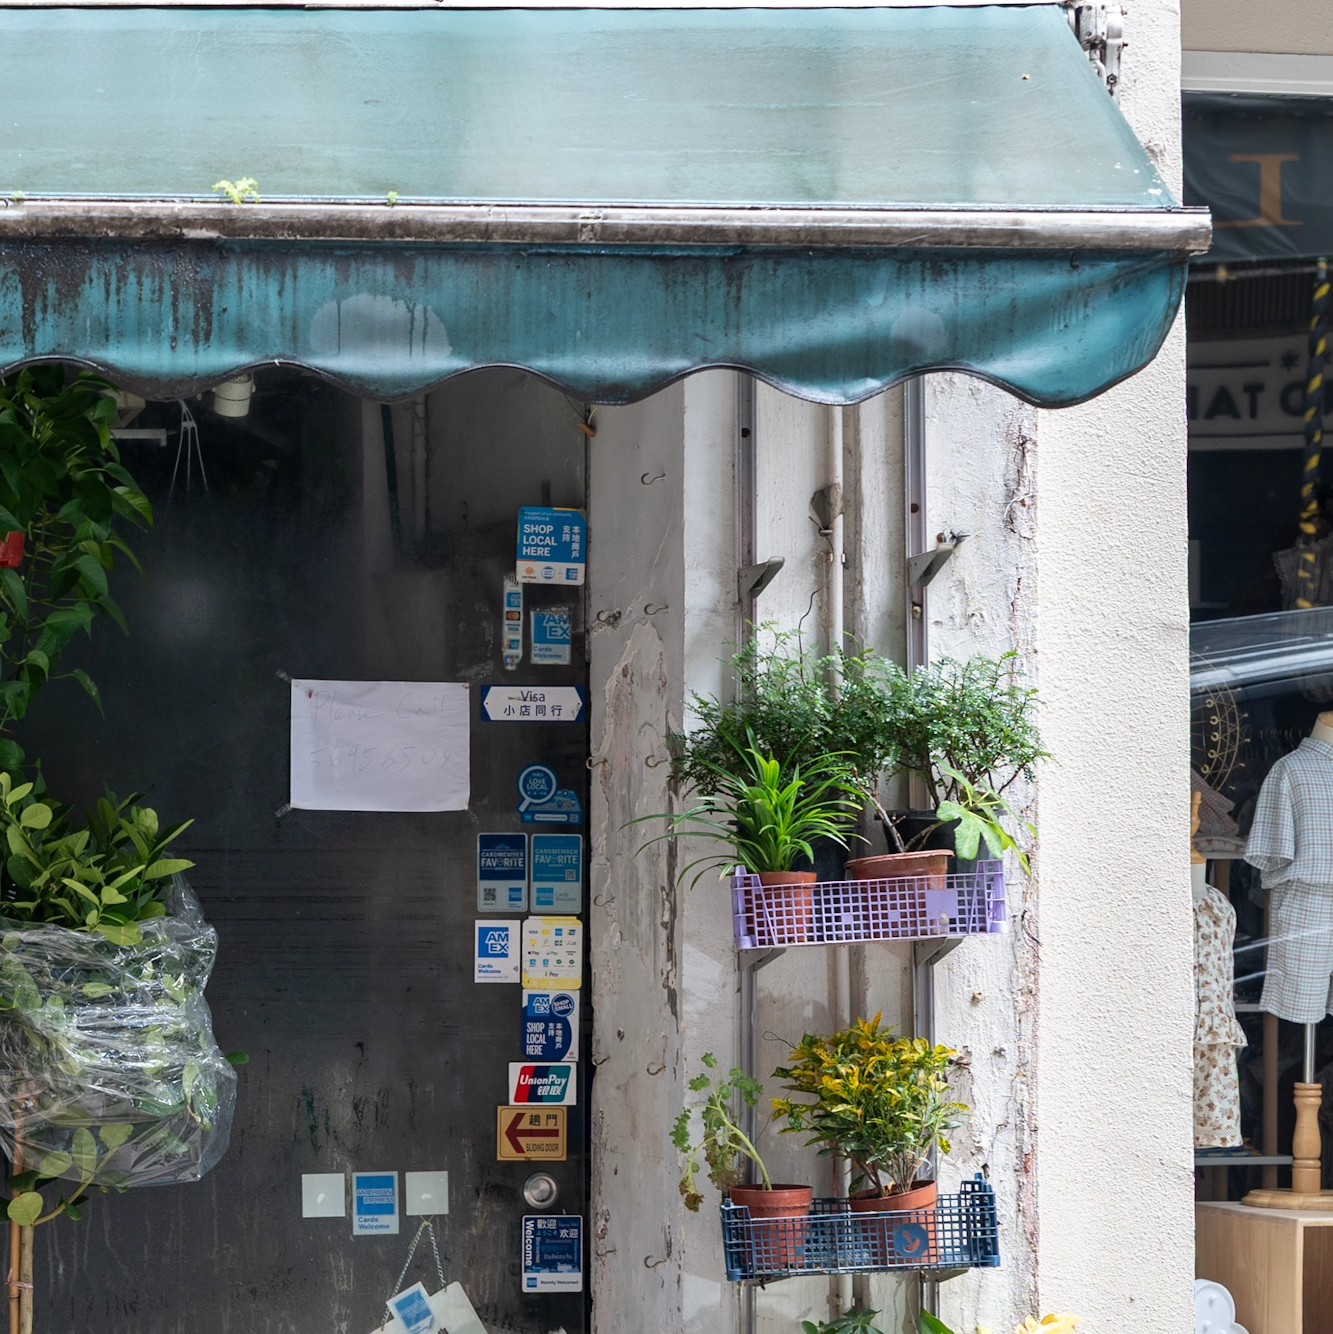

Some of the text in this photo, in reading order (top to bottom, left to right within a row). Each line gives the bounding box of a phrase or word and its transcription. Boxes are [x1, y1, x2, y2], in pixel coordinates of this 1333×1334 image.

[523, 524, 555, 534] SHOP
[523, 535, 558, 546] LOCAL
[522, 546, 551, 556] HERE
[520, 690, 546, 702] Visa
[503, 704, 563, 717] 小店同行
[488, 942, 509, 954] EX
[526, 1022, 545, 1033] SHOP
[526, 1034, 547, 1044] LOCAL
[526, 1045, 543, 1055] HERE
[519, 1074, 568, 1088] UnionPay
[526, 1143, 559, 1152] SLIDING DOOR
[525, 1220, 535, 1267] Welcome
